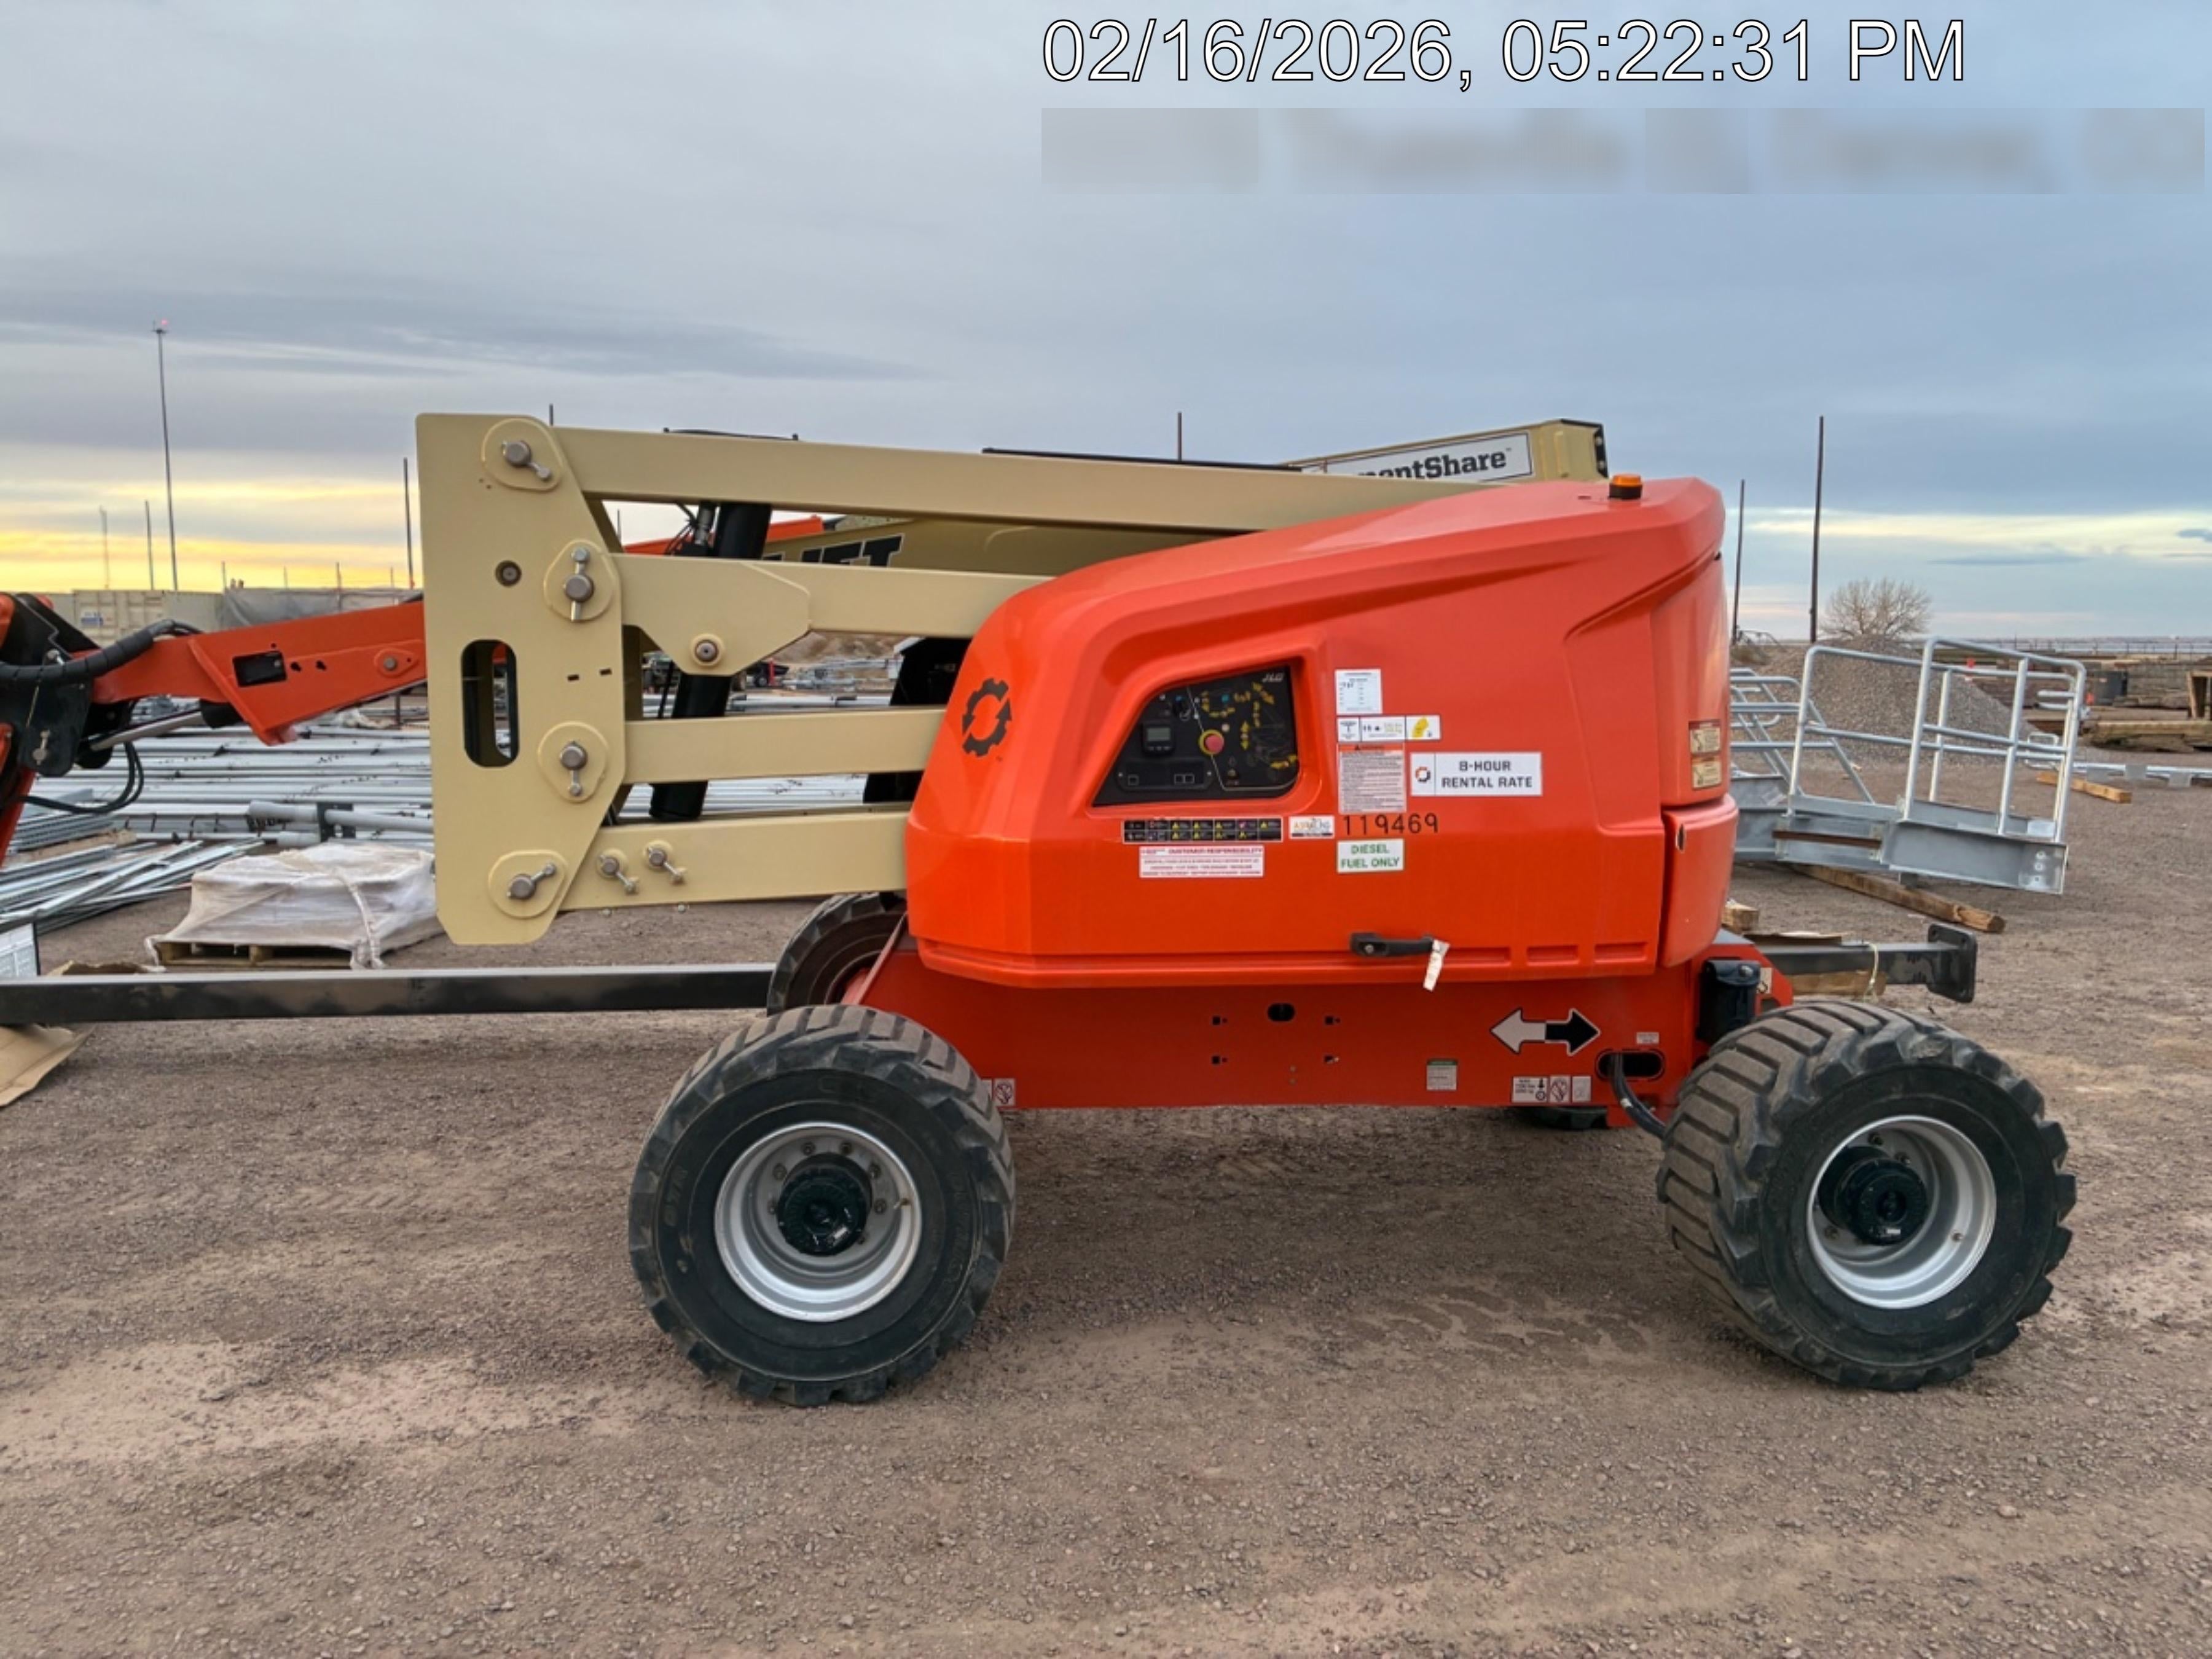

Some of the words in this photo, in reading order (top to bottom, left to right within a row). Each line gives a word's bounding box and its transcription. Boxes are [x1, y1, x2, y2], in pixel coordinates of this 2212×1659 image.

[1459, 760, 1512, 771] 8-HOUR
[1441, 776, 1493, 788] RENTAL
[1498, 775, 1533, 788] RATE
[1343, 812, 1439, 835] 119469
[1350, 844, 1390, 854] DIESEL
[1341, 858, 1368, 868] FUEL
[1371, 857, 1400, 868] ONLY
